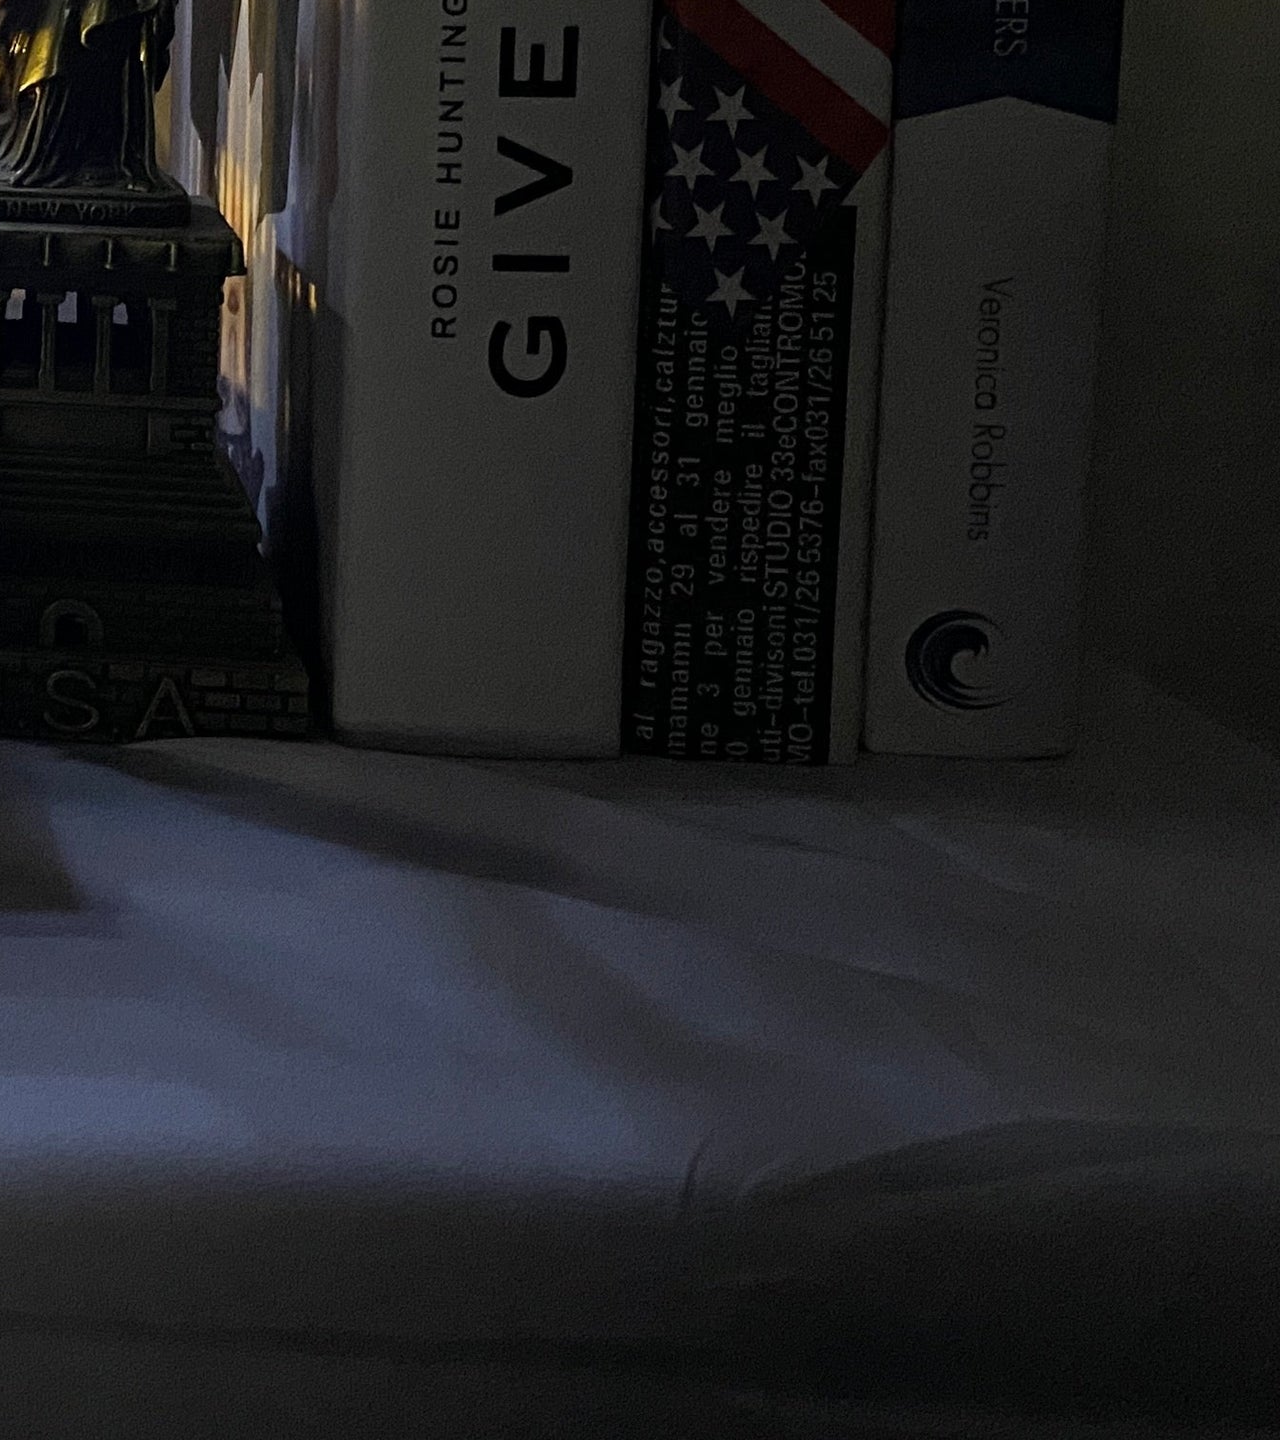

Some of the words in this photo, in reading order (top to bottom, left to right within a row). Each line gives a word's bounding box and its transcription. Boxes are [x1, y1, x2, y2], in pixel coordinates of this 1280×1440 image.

[430, 207, 461, 340] ROSIE
[812, 270, 838, 304] 25
[973, 276, 1014, 410] Veronica
[713, 345, 741, 444] meglio
[740, 423, 767, 439] il
[676, 456, 701, 487] 31
[966, 423, 1006, 542] Robbins
[673, 513, 699, 538] al
[704, 468, 733, 586] vendere
[733, 463, 766, 584] rispedire
[762, 490, 794, 599] STUDIO
[670, 563, 695, 596] 29
[704, 613, 730, 657] per
[729, 607, 757, 717] gennaio
[696, 682, 721, 697] 3
